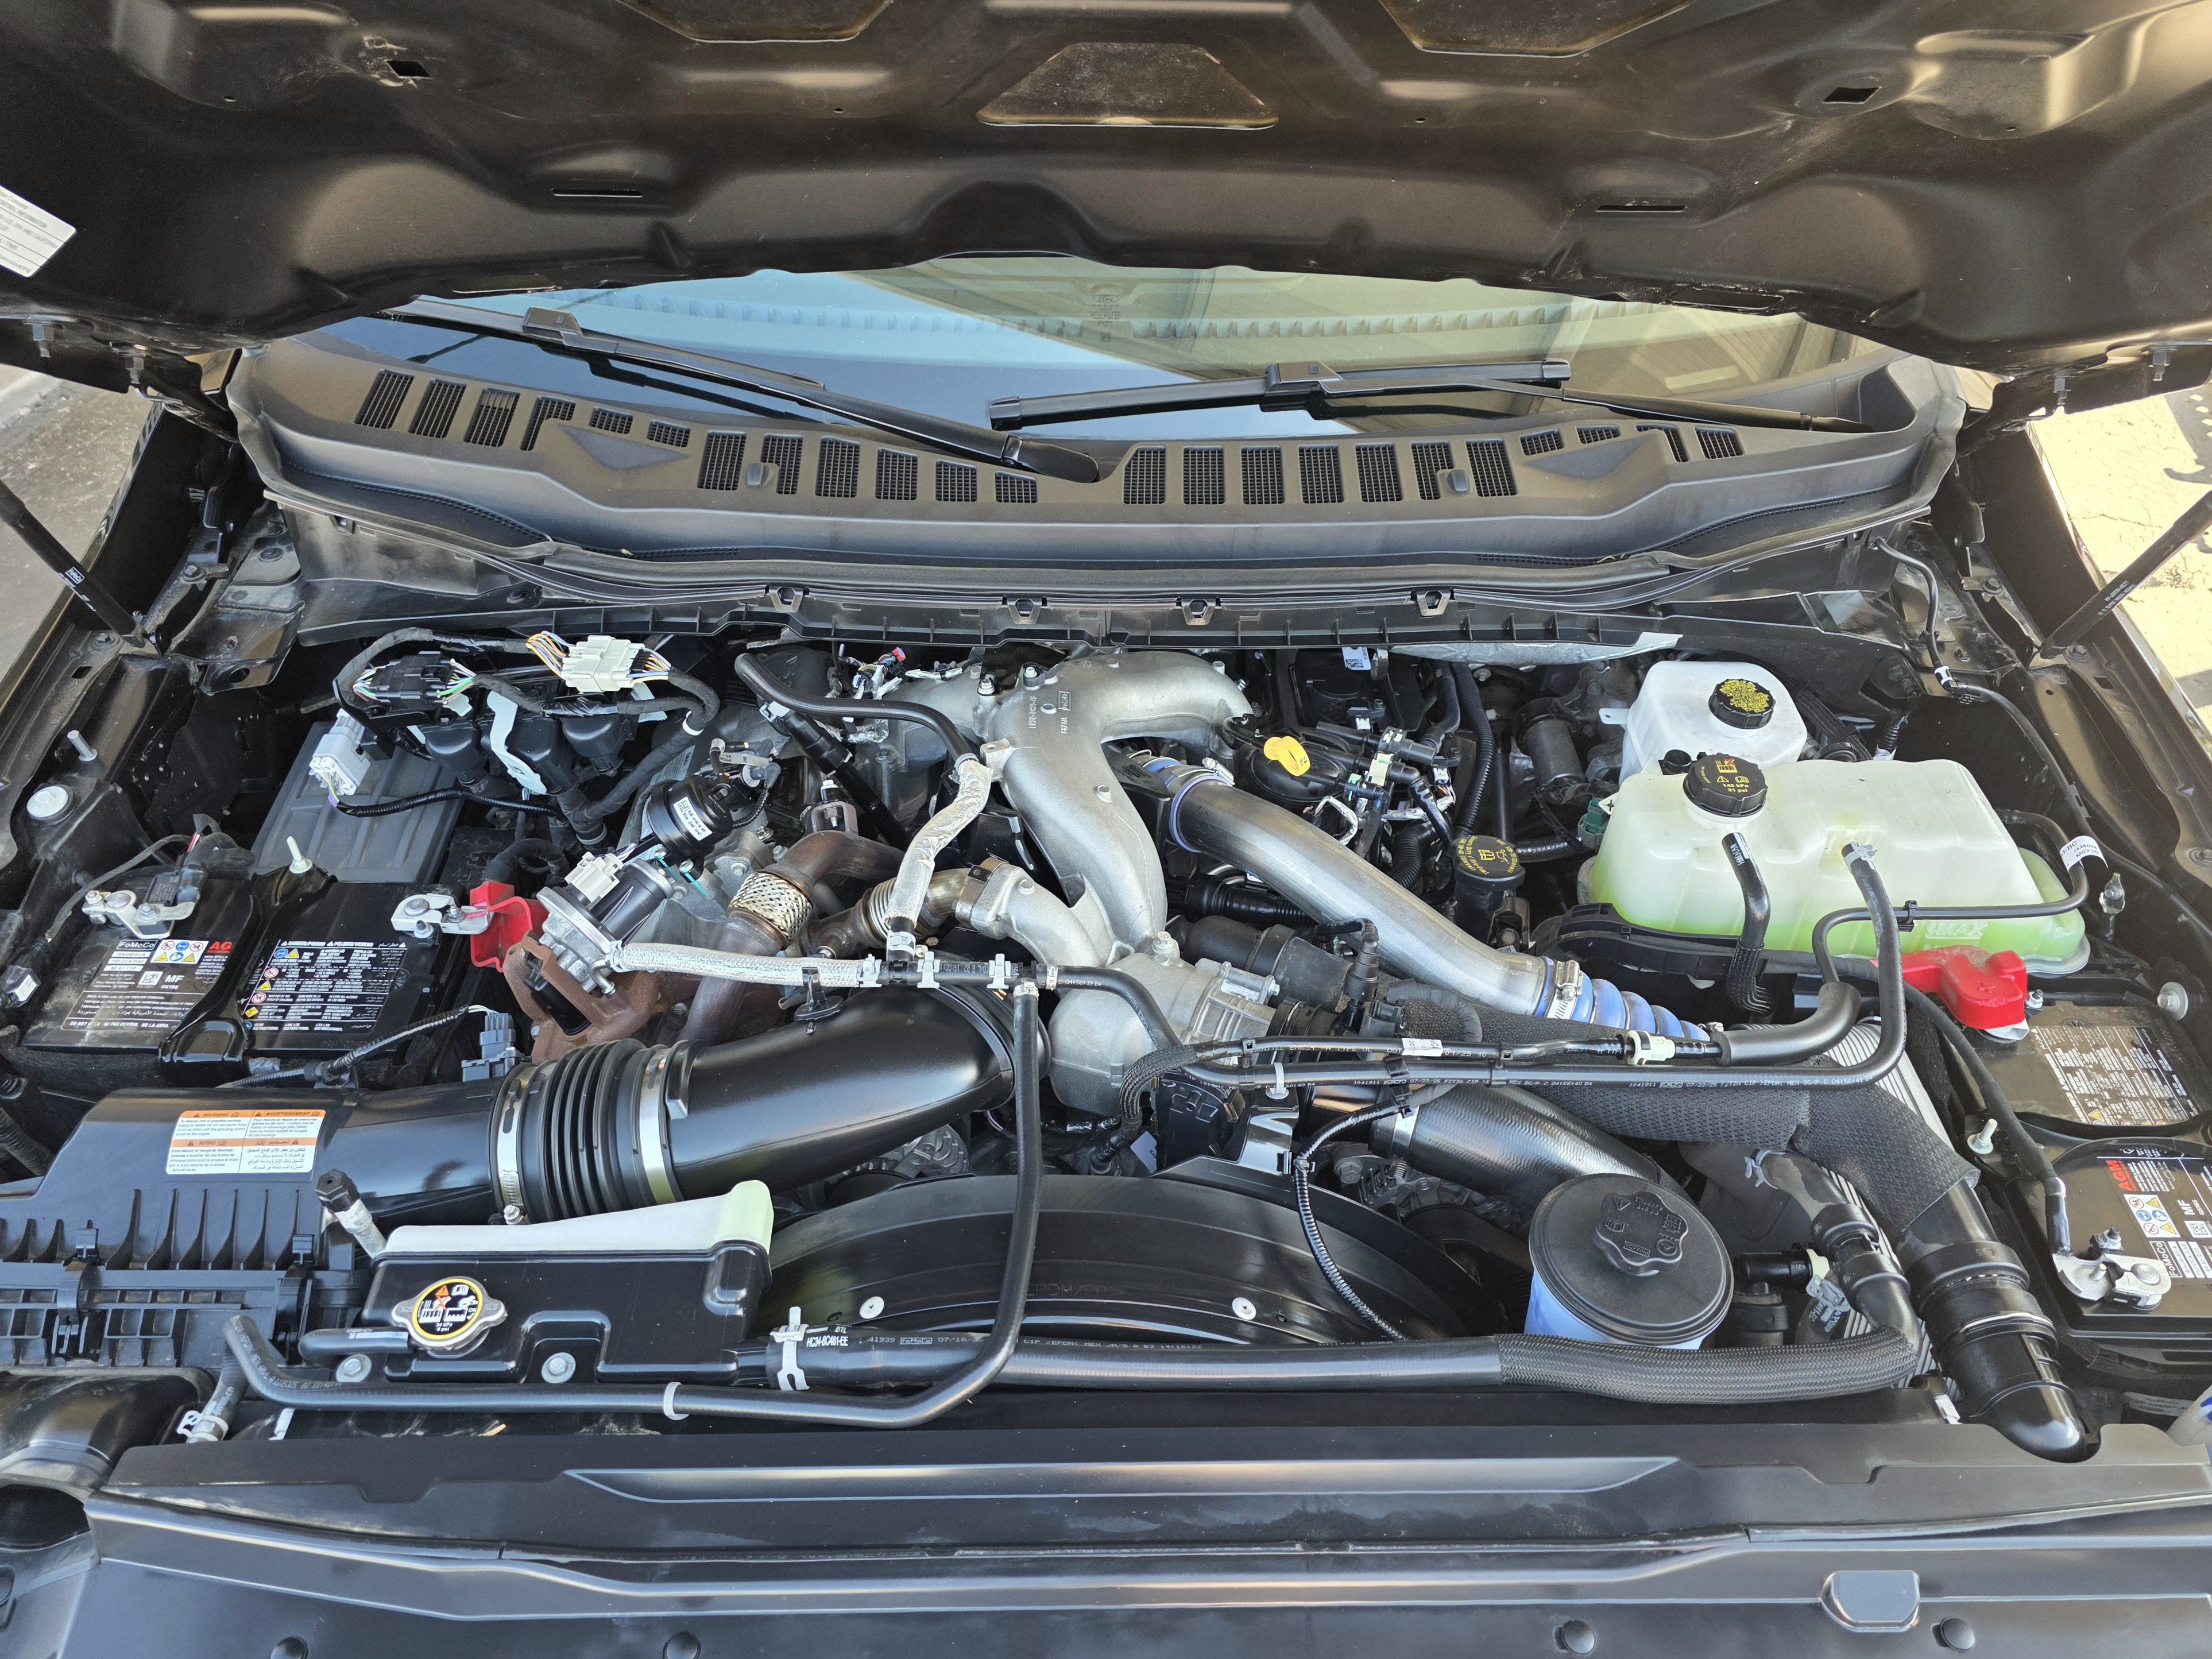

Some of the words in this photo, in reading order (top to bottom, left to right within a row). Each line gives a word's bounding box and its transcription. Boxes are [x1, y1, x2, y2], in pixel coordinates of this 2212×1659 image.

[208, 941, 233, 950] AG
[2106, 1159, 2133, 1192] AGM
[2177, 1199, 2196, 1215] MF
[2156, 1242, 2179, 1277] FoMoCo
[901, 1337, 933, 1345] FoMoCo
